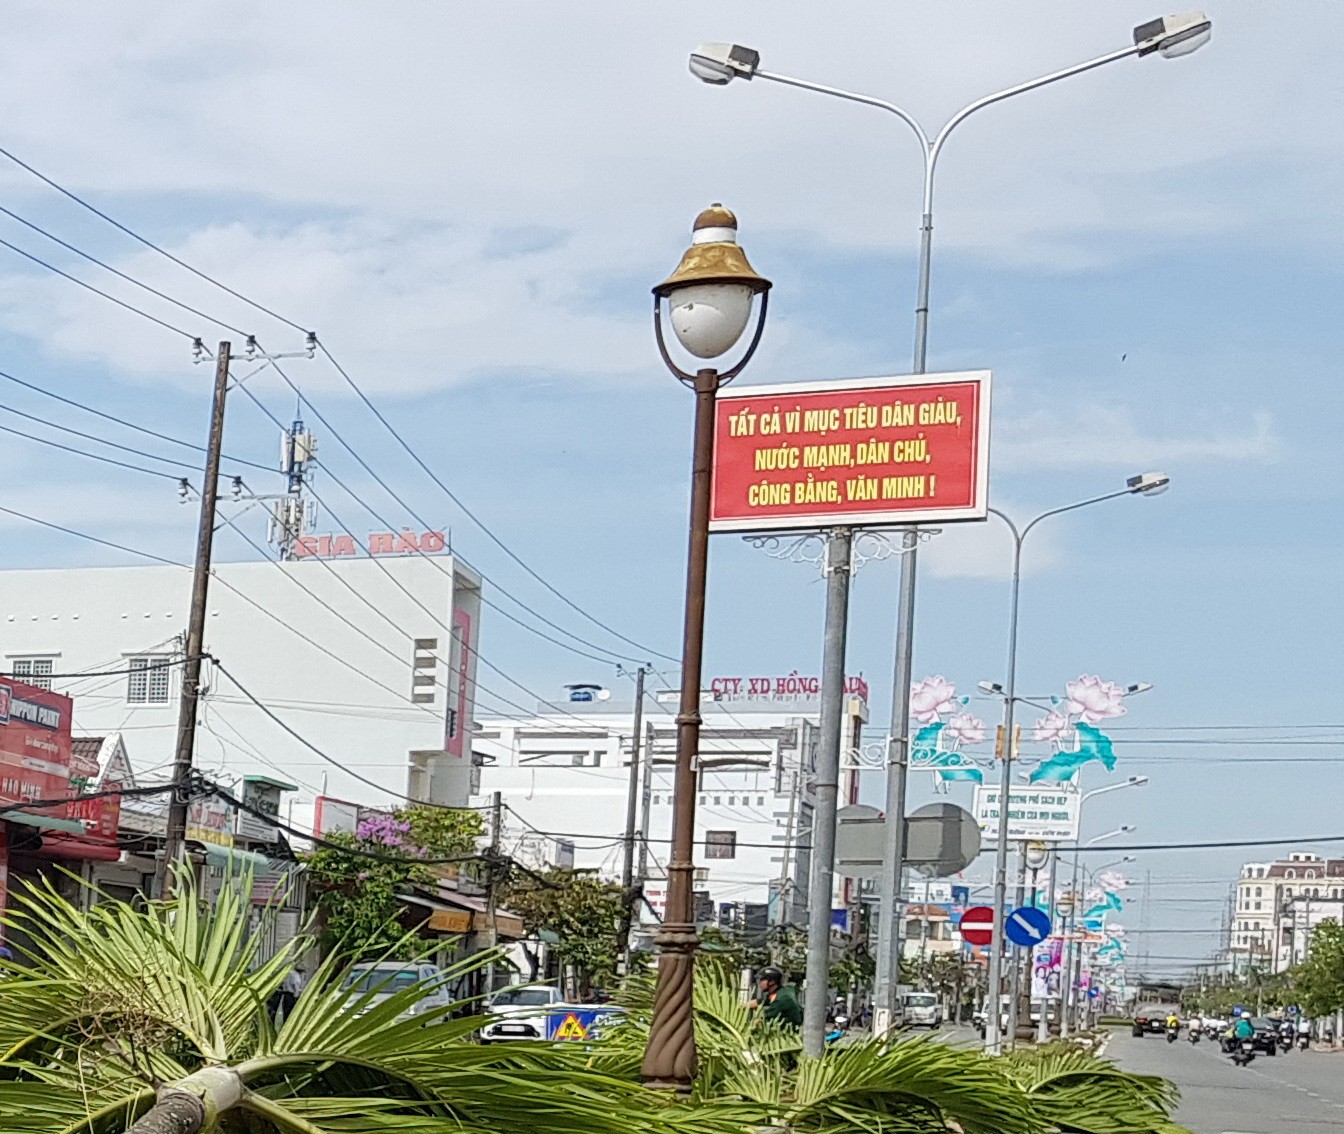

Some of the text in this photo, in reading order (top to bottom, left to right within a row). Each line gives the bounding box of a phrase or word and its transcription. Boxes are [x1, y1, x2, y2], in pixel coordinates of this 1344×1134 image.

[729, 396, 962, 437] TẤT CẢ VÌ MỤC TIÊU DÂN GIÀU,
[755, 442, 799, 471] NƯỚC
[857, 438, 889, 465] DÂN
[893, 433, 931, 463] CHỦ,
[749, 481, 790, 507] CÔNG
[794, 472, 842, 504] BẰNG,
[846, 474, 878, 501] VĂN
[882, 475, 925, 499] MINH
[294, 534, 357, 557] GIA
[710, 669, 820, 695] CTY XD HỒNG
